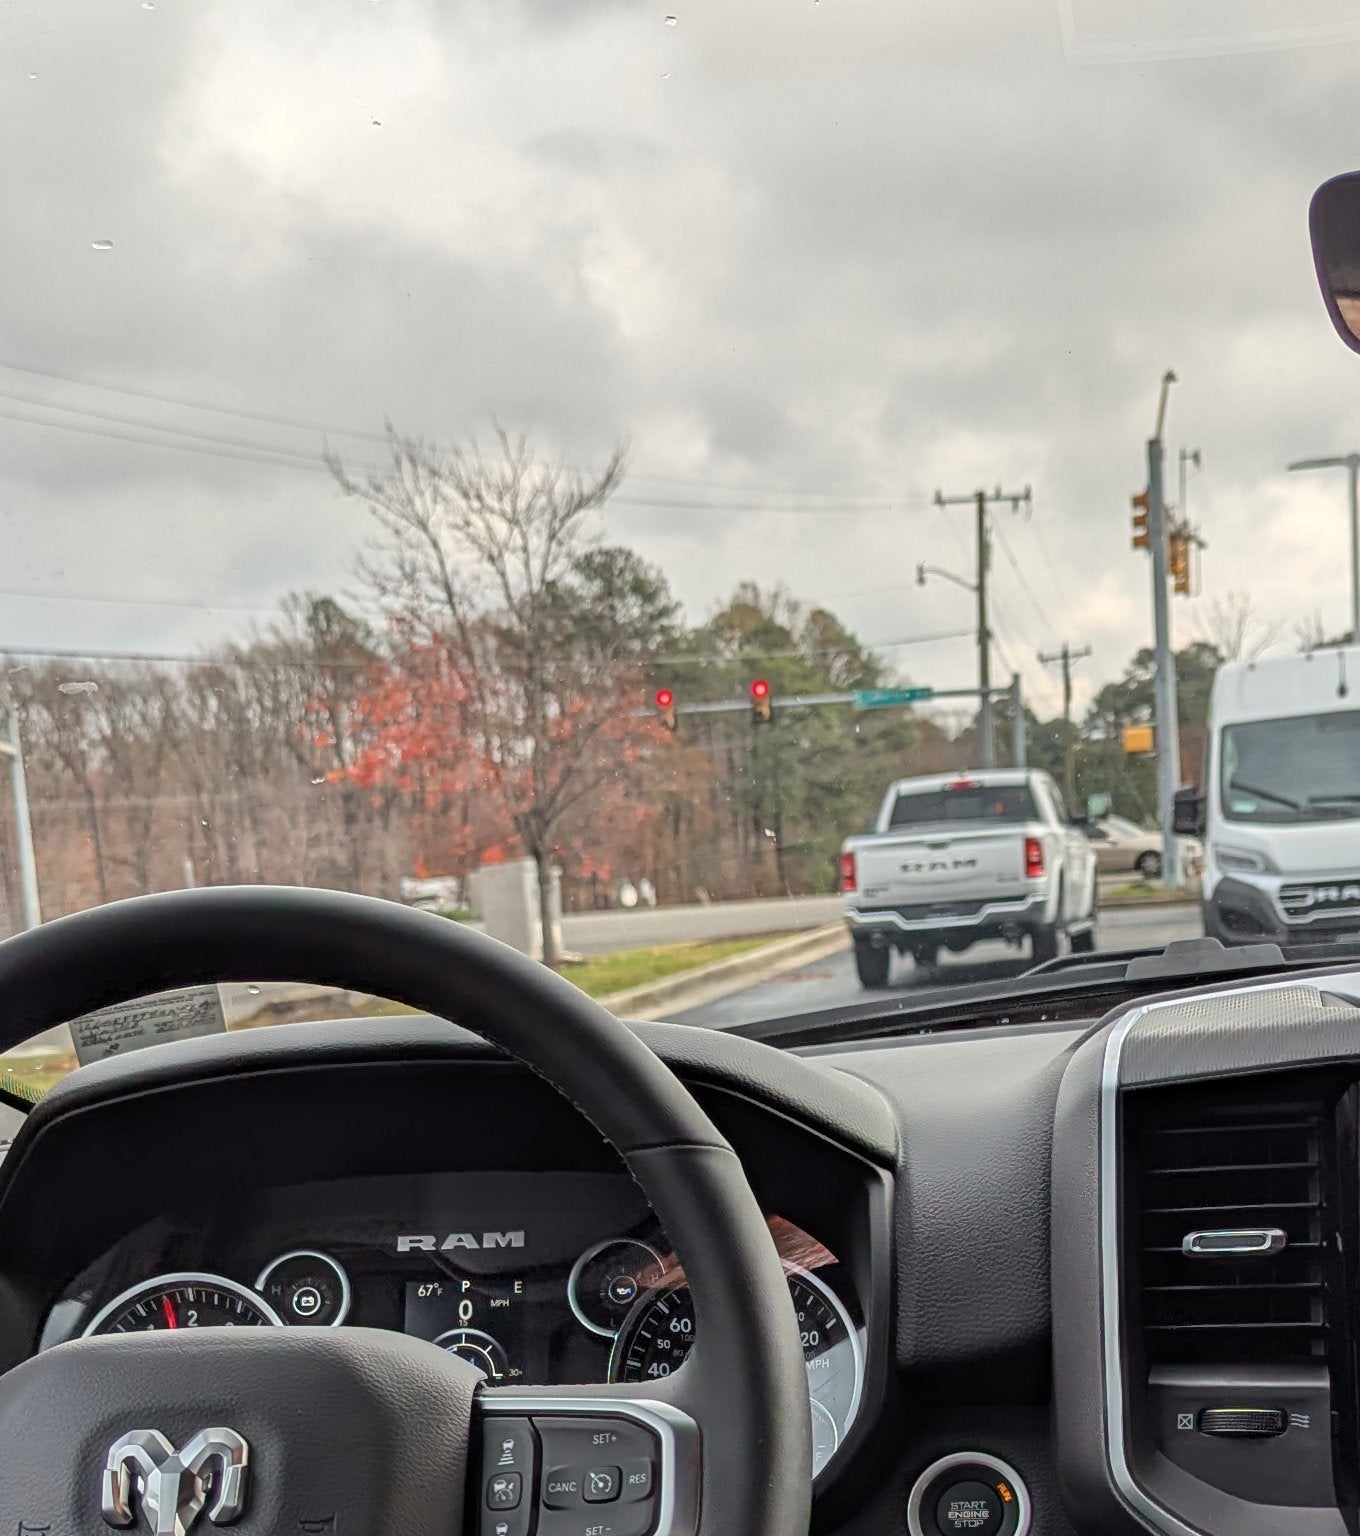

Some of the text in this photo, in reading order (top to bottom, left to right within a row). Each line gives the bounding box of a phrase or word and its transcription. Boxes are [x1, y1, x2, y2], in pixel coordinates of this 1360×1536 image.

[397, 1231, 525, 1252] RAM
[490, 1298, 510, 1308] MPH
[187, 1310, 198, 1327] 2
[669, 1317, 692, 1333] 60
[657, 1339, 671, 1349] 50
[800, 1330, 819, 1347] 20
[648, 1362, 670, 1377] 40
[629, 1473, 646, 1484] RES
[548, 1481, 577, 1493] CANC
[950, 1501, 987, 1510] START
[948, 1510, 990, 1519] ENGINE
[954, 1519, 984, 1528] STOP
